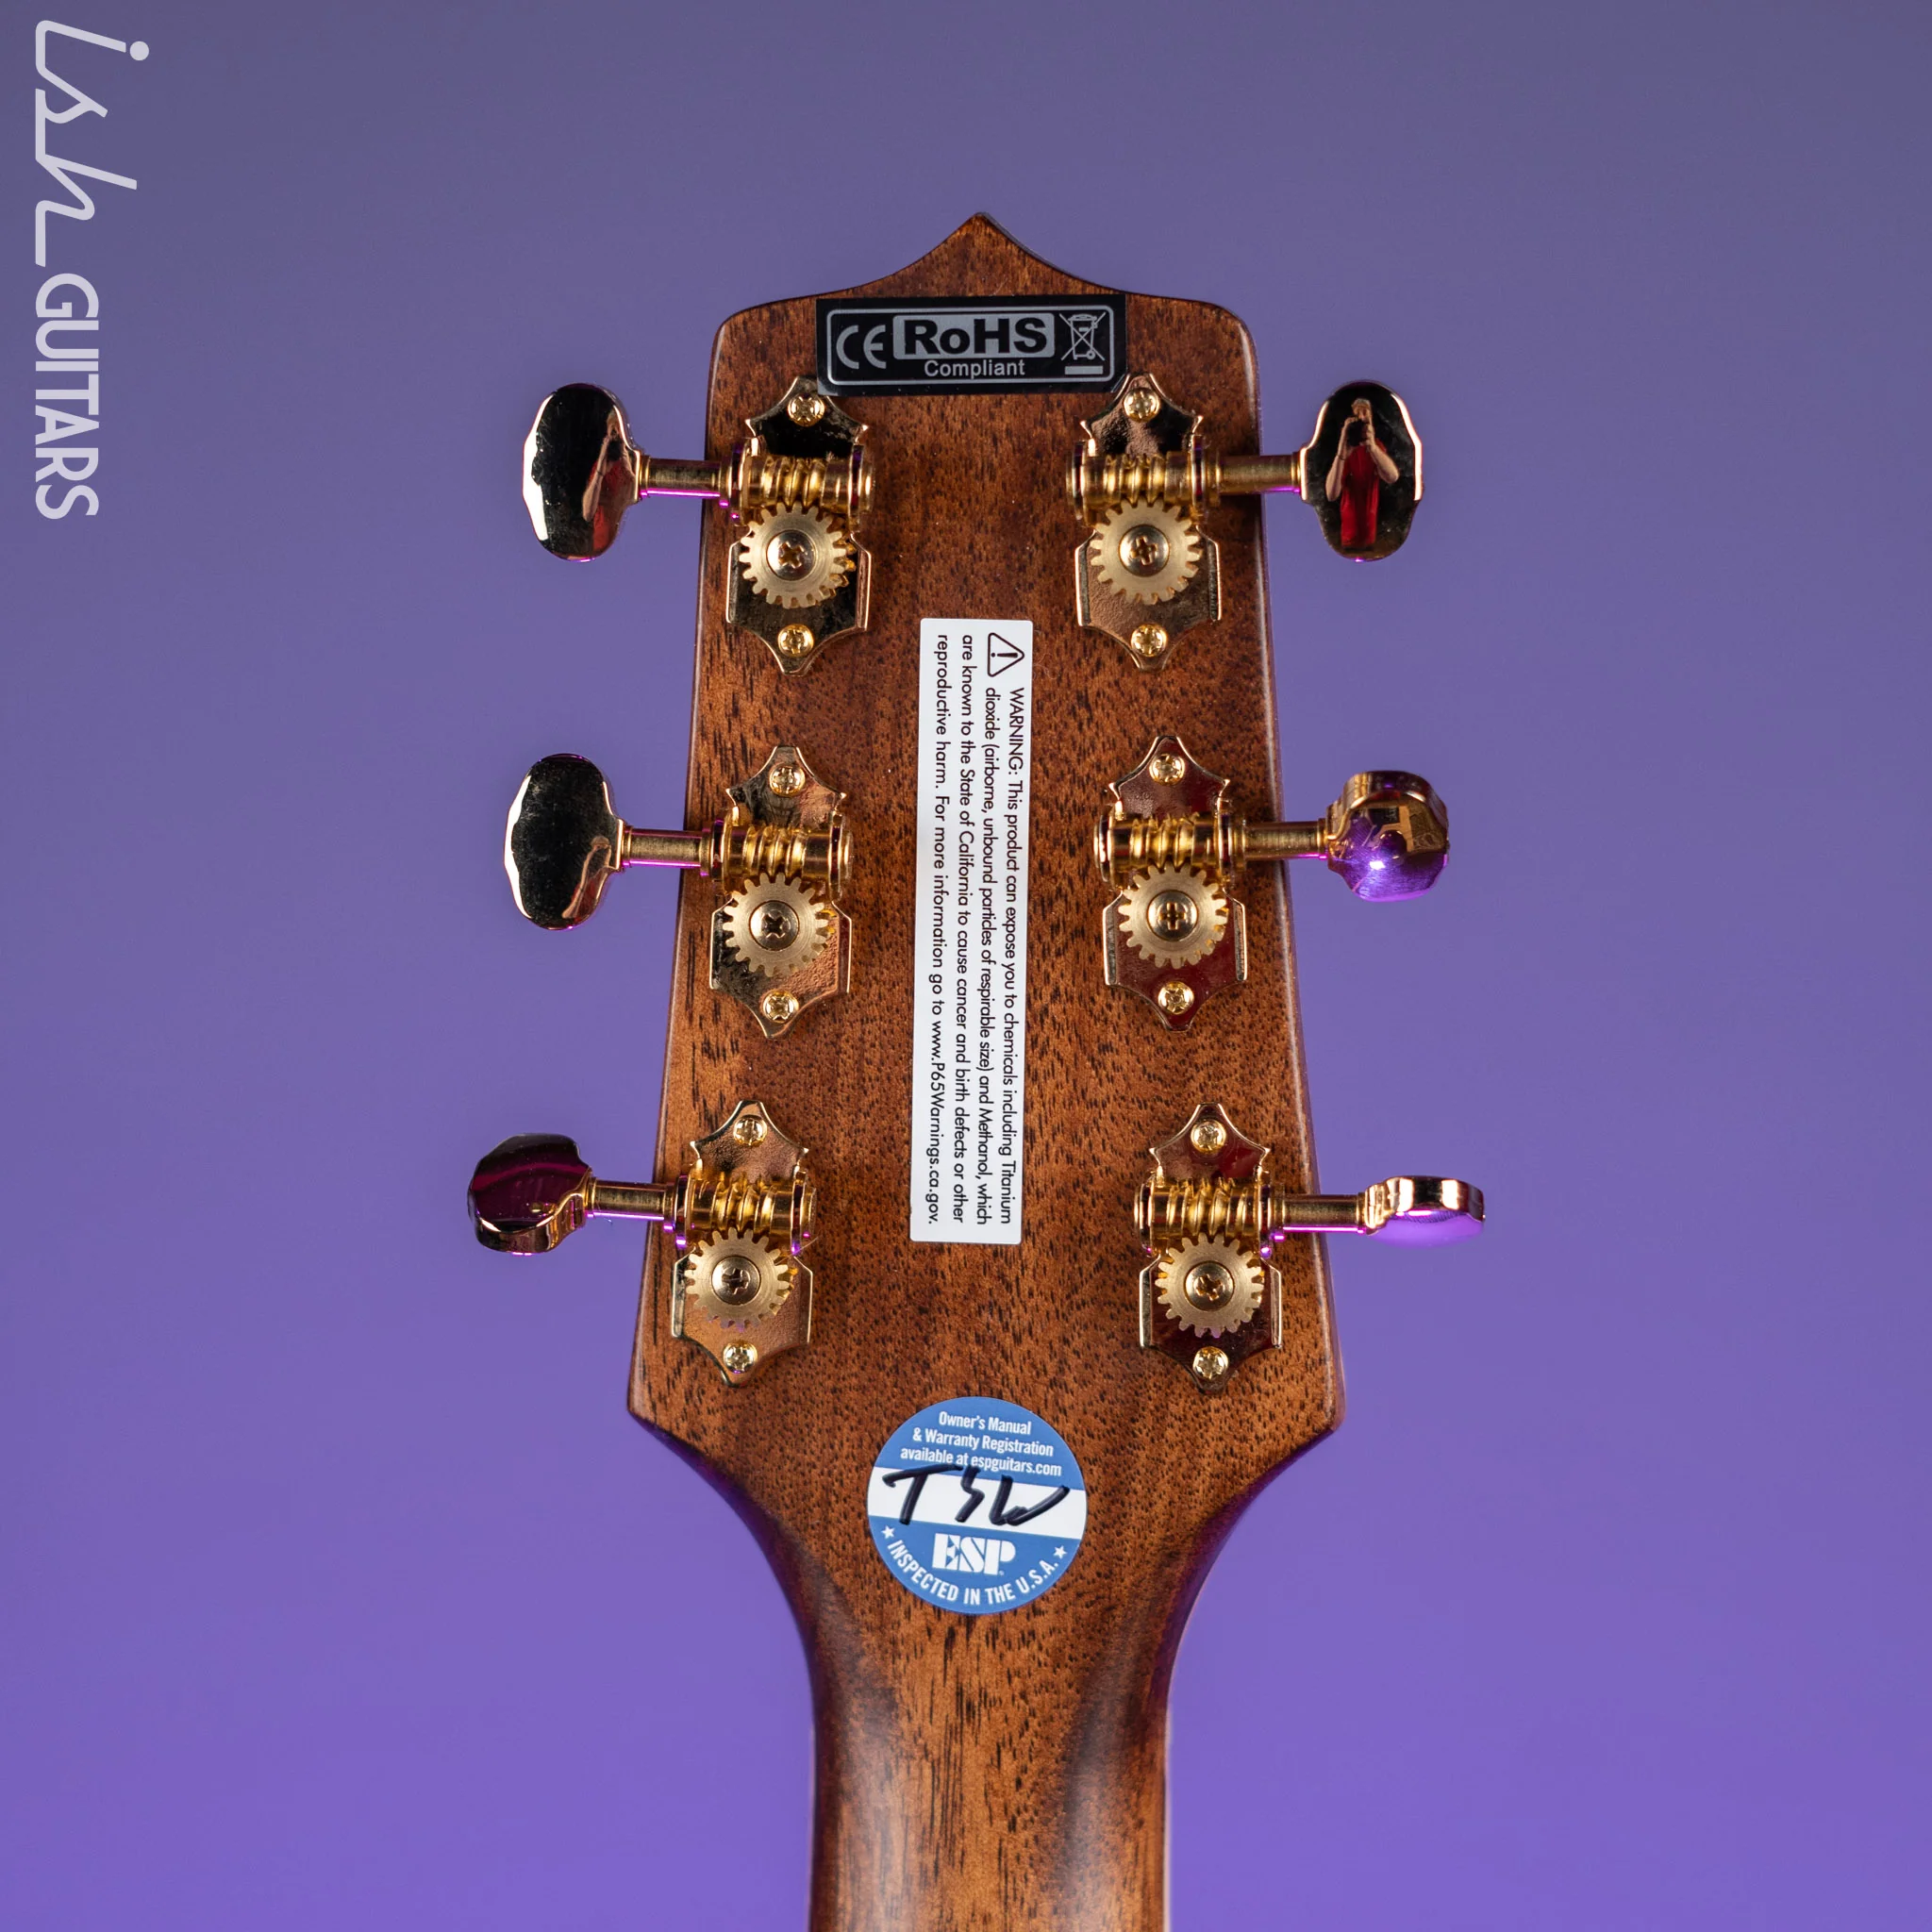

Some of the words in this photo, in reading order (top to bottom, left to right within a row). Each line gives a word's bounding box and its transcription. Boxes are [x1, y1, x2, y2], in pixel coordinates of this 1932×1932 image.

[904, 317, 1048, 356] RoHS
[924, 358, 1025, 379] Compliant
[962, 634, 973, 660] are
[933, 634, 953, 736] reproductive
[961, 666, 977, 716] known
[960, 721, 974, 736] to
[985, 687, 1002, 740] dioxide
[1008, 687, 1024, 775] WARNING:
[935, 741, 951, 789] harm.
[960, 740, 976, 764] the
[959, 769, 975, 806] State
[981, 743, 1000, 813] (airborne,
[1008, 779, 1024, 810] This
[935, 796, 950, 822] For
[958, 810, 975, 826] of
[934, 826, 945, 870] more
[982, 818, 999, 884] unbound
[1003, 814, 1023, 872] product
[958, 830, 974, 906] California
[1006, 875, 1017, 902] can
[932, 875, 950, 968] information
[958, 910, 972, 926] to
[978, 888, 997, 946] particles
[1002, 907, 1016, 958] expose
[957, 930, 968, 974] cause
[981, 949, 997, 965] of
[928, 974, 942, 994] go
[1001, 962, 1015, 990] you
[931, 1000, 945, 1015] to
[956, 978, 967, 1029] cancer
[976, 968, 996, 1038] respirable
[1004, 993, 1018, 1008] to
[956, 1034, 971, 1063] and
[975, 1041, 994, 1072] size)
[1003, 1012, 1020, 1085] chemicals
[955, 1068, 971, 1102] birth
[978, 1075, 994, 1104] and
[924, 1021, 945, 1224] www.P65Warnings.ca.gov.
[954, 1107, 971, 1158] defects
[998, 1090, 1018, 1157] including
[974, 1108, 994, 1179] Methanol,
[954, 1163, 964, 1180] or
[953, 1183, 969, 1223] other
[976, 1183, 992, 1224] which
[1000, 1160, 1016, 1224] Titanium
[912, 1427, 923, 1441] &
[925, 1428, 979, 1450] Warranty
[982, 1436, 1054, 1457] Registration
[939, 1411, 986, 1429] Owner's
[988, 1416, 1031, 1435] Manual
[900, 1448, 954, 1464] available
[957, 1454, 969, 1466] at
[971, 1457, 1062, 1476] espguitars.com
[887, 1540, 959, 1602] INSPECTED
[964, 1588, 980, 1605] IN
[985, 1584, 1016, 1605] THE
[1015, 1559, 1059, 1594] U.S.A.
[931, 1533, 1016, 1575] ESP
